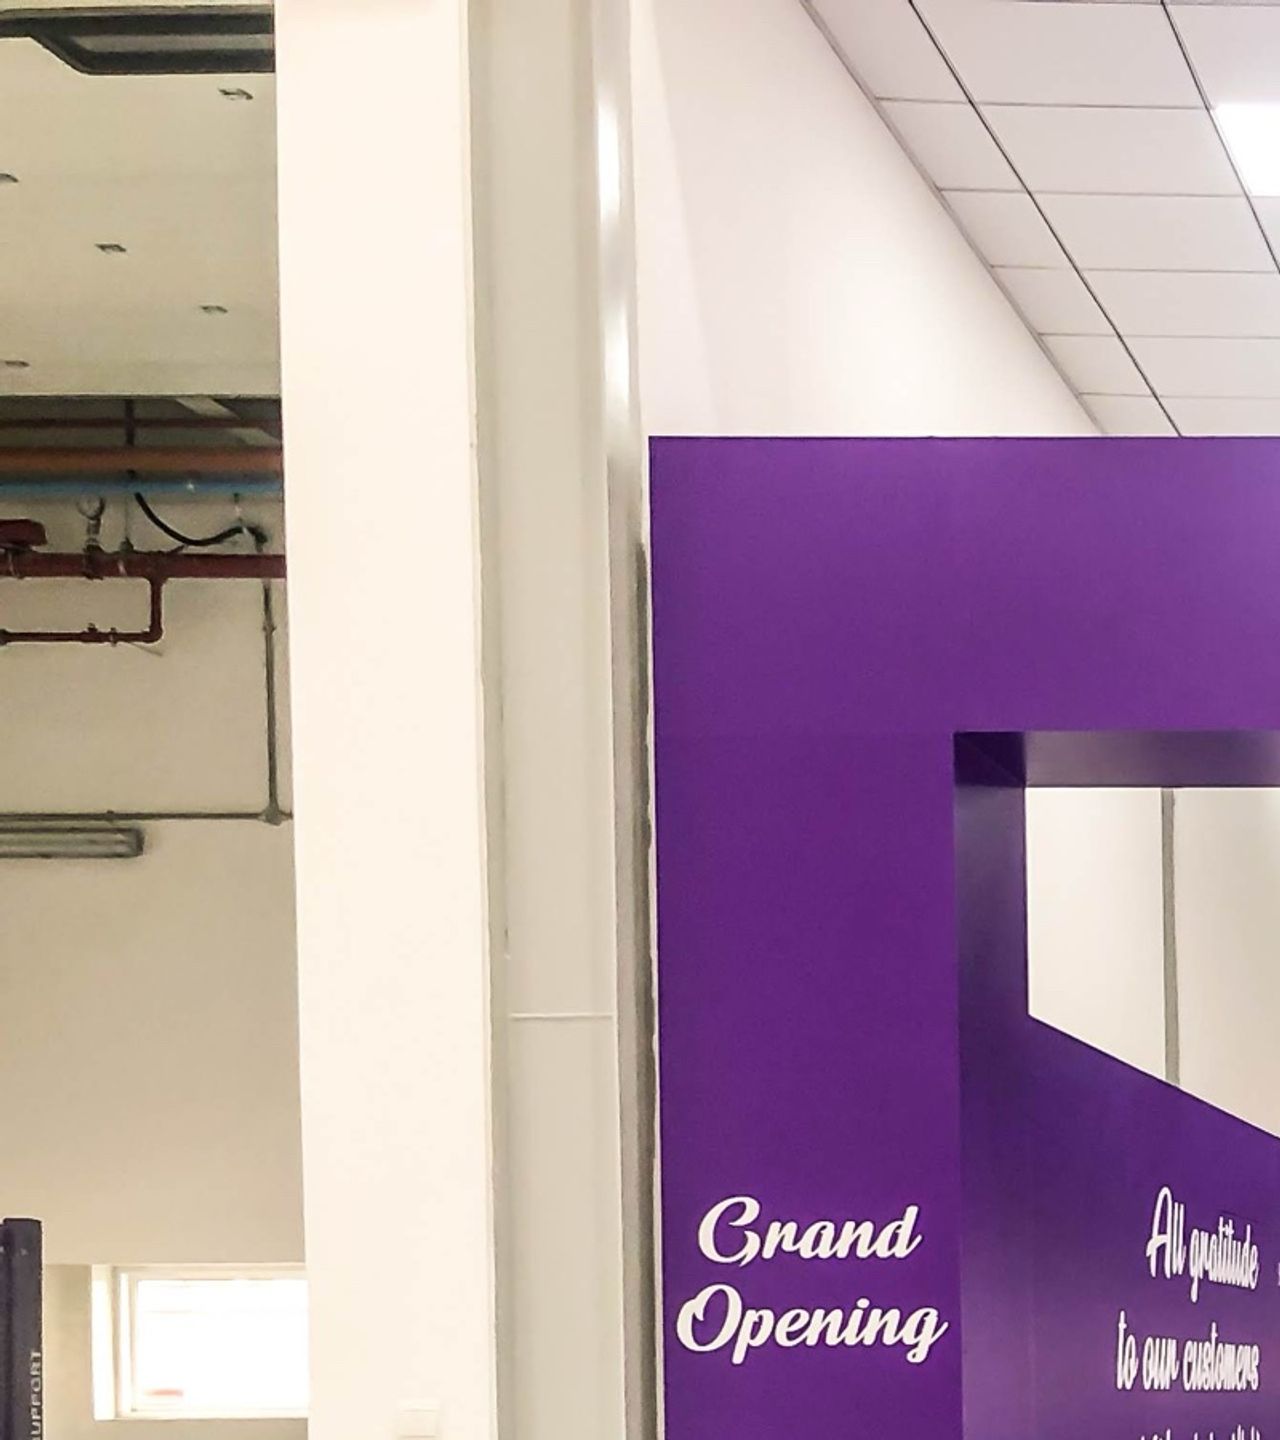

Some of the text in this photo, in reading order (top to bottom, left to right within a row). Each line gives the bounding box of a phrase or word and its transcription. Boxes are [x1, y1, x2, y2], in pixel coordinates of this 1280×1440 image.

[698, 1196, 922, 1267] Grand
[1146, 1186, 1260, 1304] All gratitude
[677, 1284, 949, 1366] Opening
[1116, 1310, 1260, 1391] to our customers
